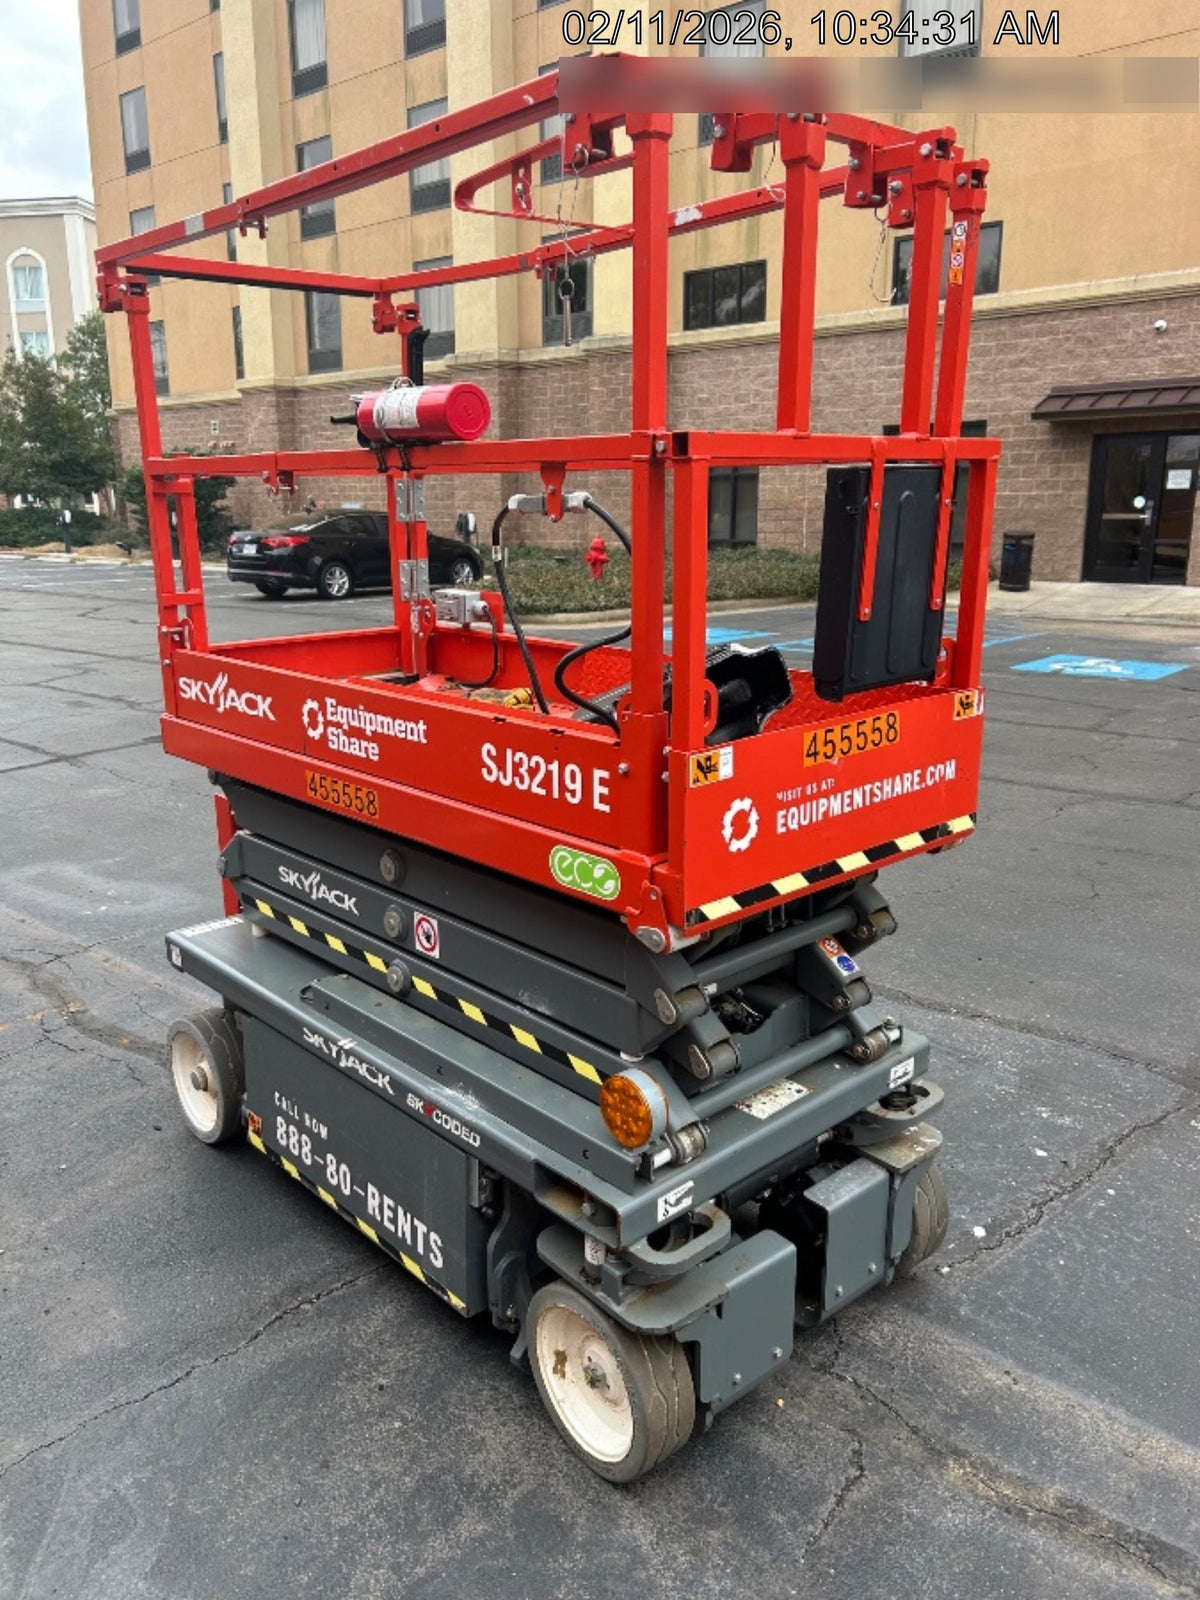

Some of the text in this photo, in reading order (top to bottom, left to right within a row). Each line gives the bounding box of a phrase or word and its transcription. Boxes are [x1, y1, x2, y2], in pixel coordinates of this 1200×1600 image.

[179, 671, 276, 722] SKYJACK
[325, 697, 428, 745] Equipment
[326, 727, 380, 762] Share
[805, 712, 899, 764] 455558
[307, 772, 379, 818] 455558
[480, 742, 611, 813] SJ3219 E
[776, 758, 957, 834] EQUIPMENTSHARE.COM
[278, 864, 360, 915] SKYJACK
[552, 847, 618, 896] eco
[302, 1026, 396, 1096] SKYJACK
[274, 1090, 328, 1140] CALL NOW
[276, 1115, 445, 1268] 888-80-RENTS
